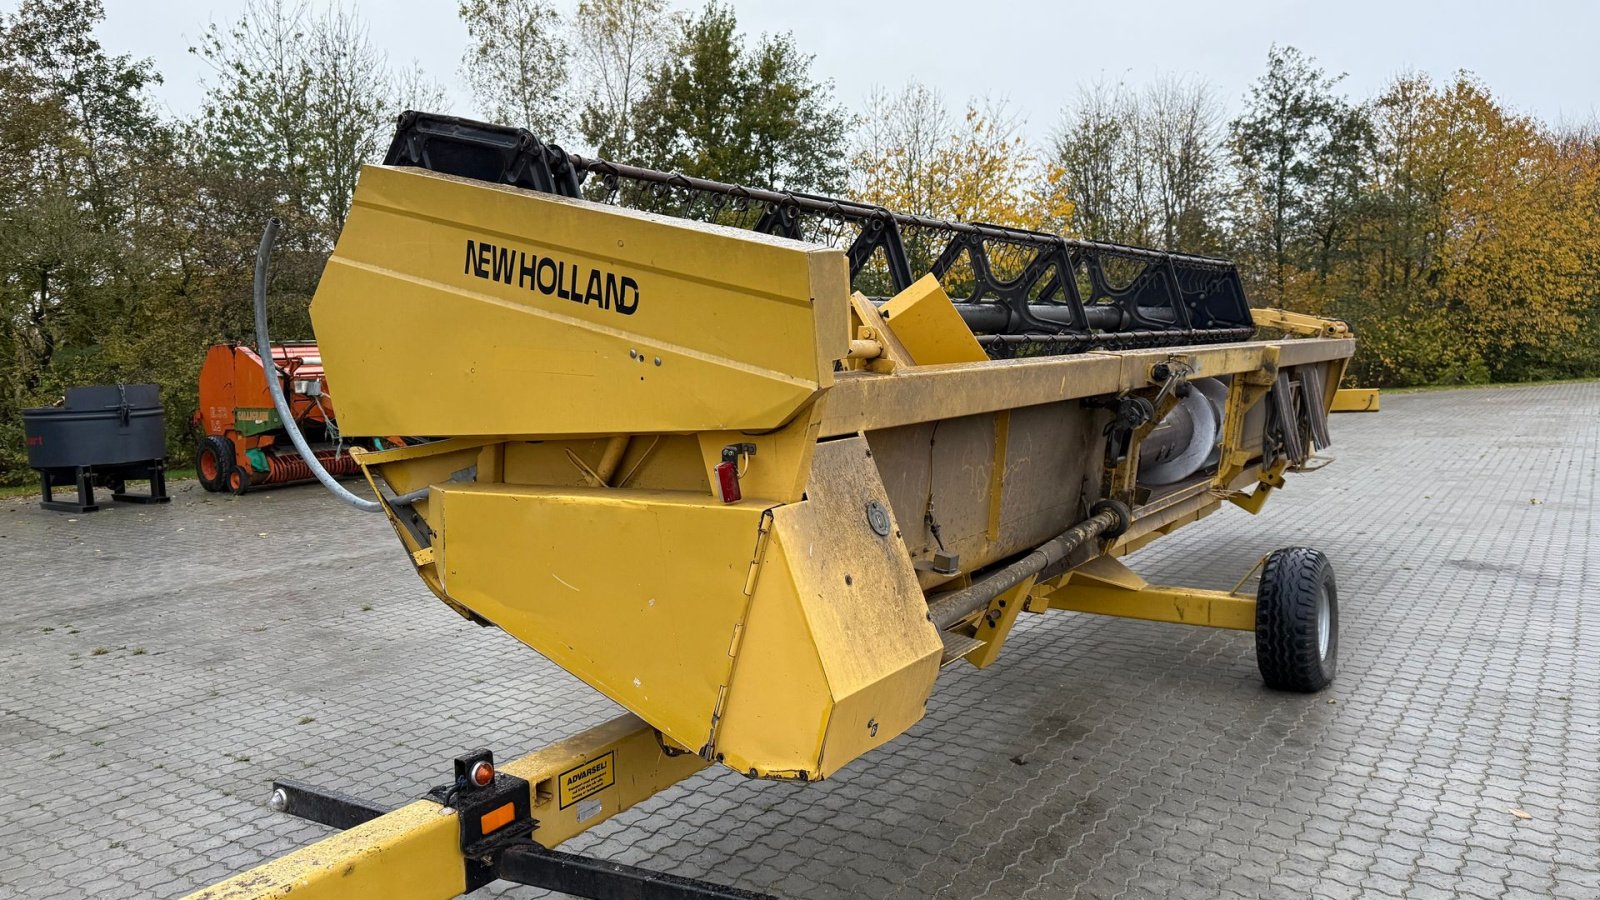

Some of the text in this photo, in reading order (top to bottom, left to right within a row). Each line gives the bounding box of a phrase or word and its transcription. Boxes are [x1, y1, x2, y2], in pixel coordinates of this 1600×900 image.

[464, 239, 640, 315] NEW HOLLAND
[567, 760, 607, 785] ADVARSEL!
